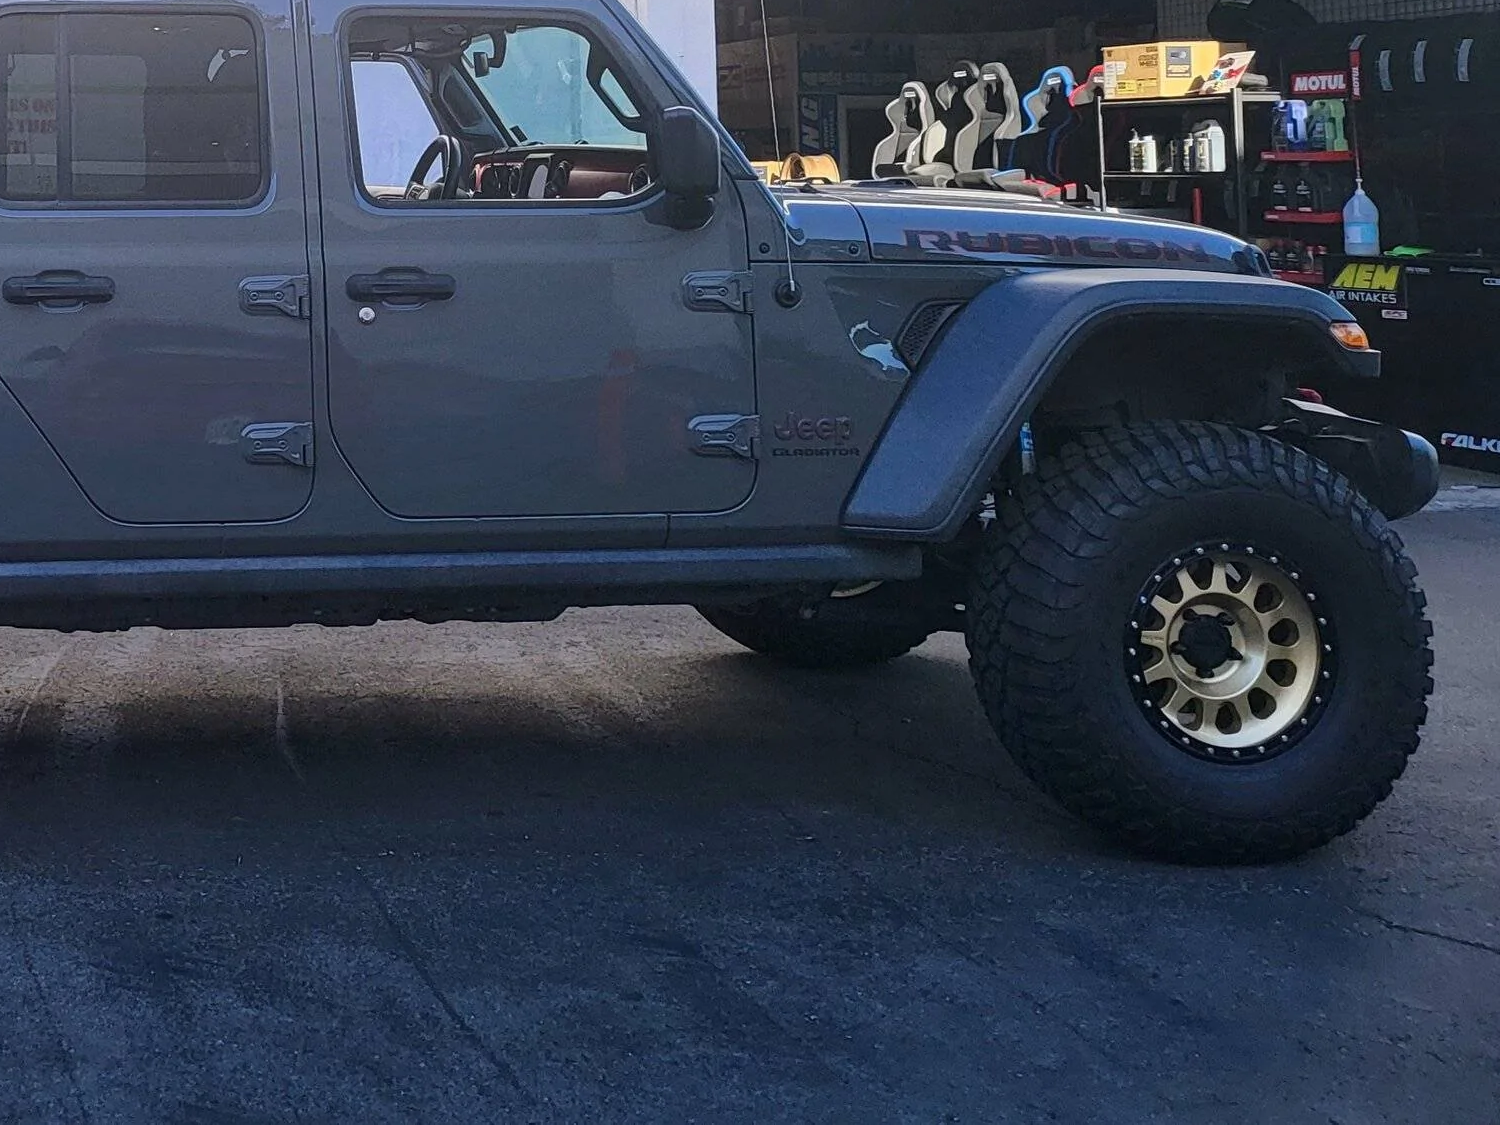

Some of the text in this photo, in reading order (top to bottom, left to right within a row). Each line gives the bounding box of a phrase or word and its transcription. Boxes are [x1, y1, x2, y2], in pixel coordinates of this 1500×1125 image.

[1294, 74, 1346, 91] MOTUL
[1351, 66, 1361, 96] MOTUL
[902, 230, 1211, 263] RUBICON
[1331, 262, 1401, 290] AEM
[1329, 290, 1397, 304] AIR INTAKES
[774, 411, 852, 445] Jeep
[772, 447, 860, 457] GLADIATOR
[1441, 432, 1500, 453] FALK
